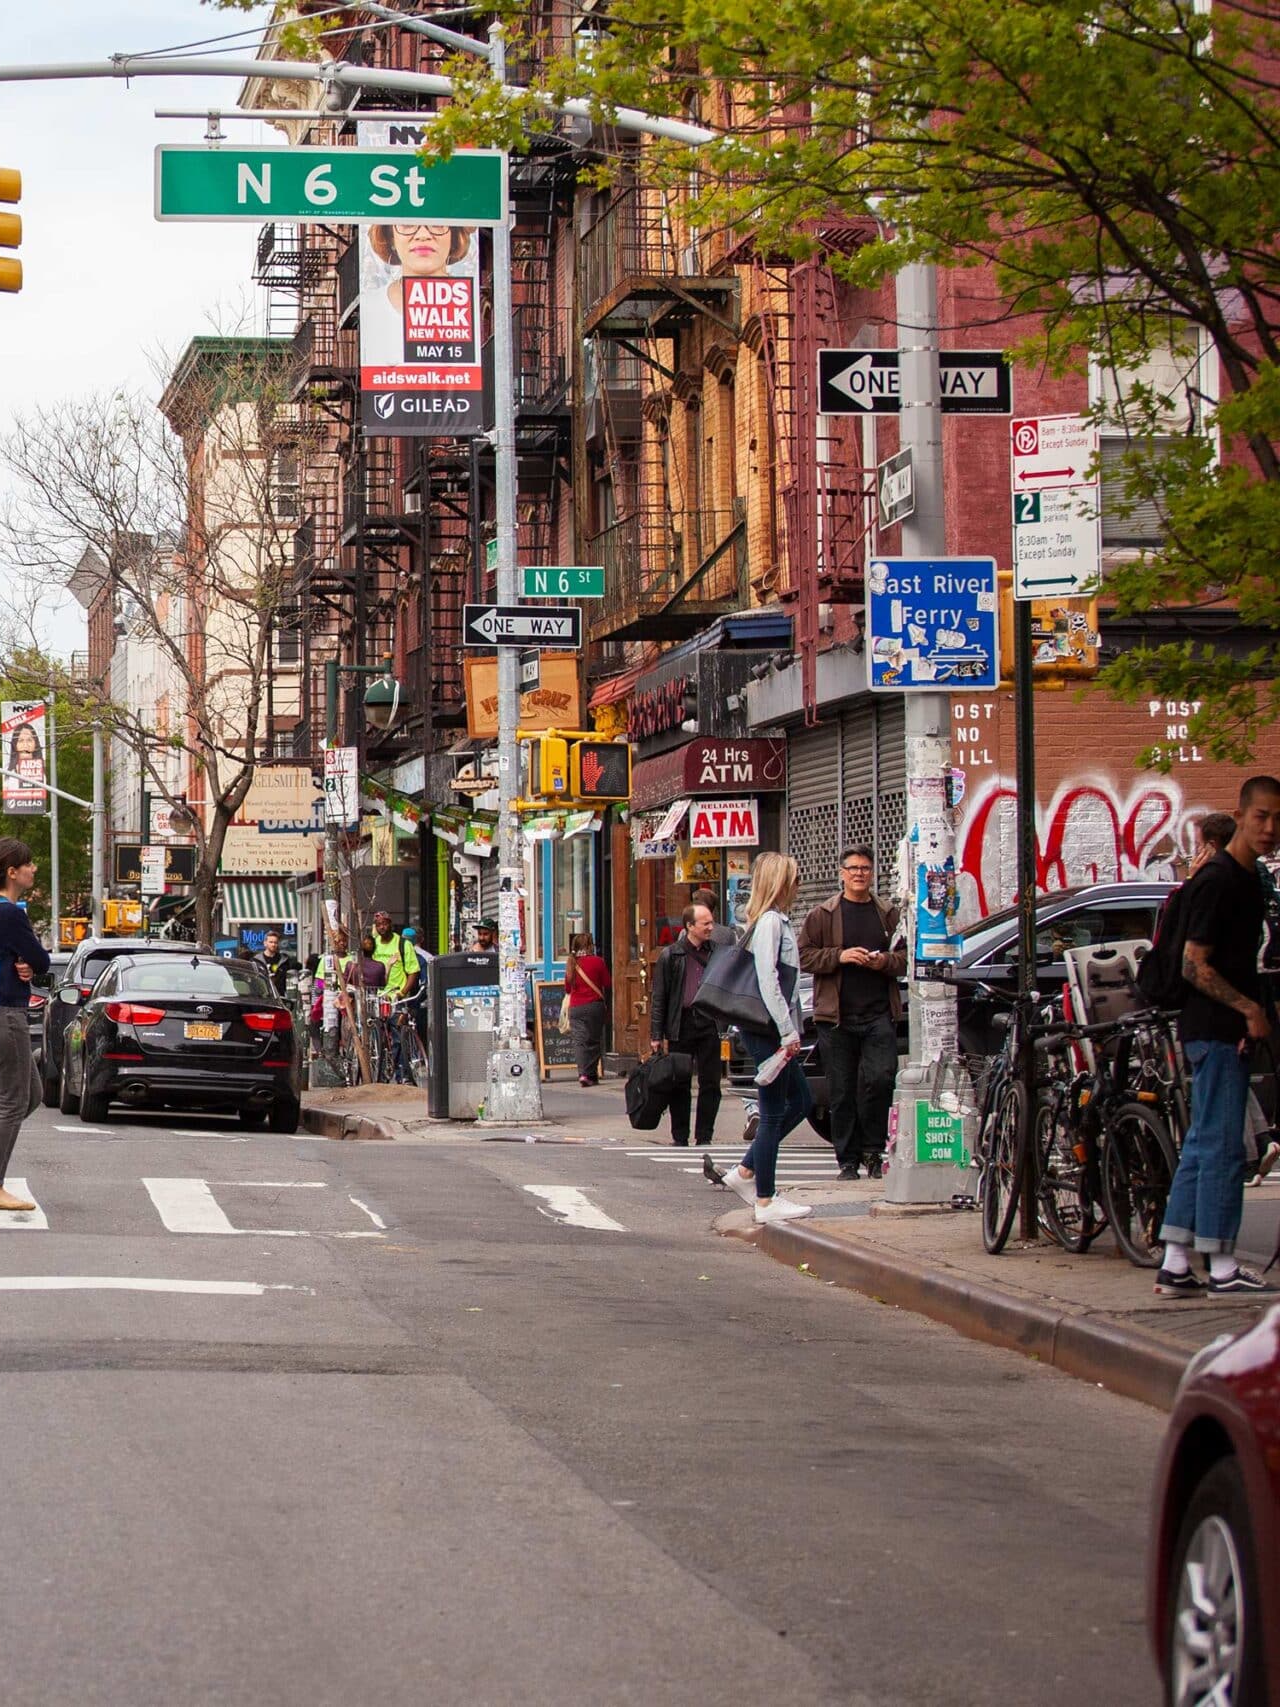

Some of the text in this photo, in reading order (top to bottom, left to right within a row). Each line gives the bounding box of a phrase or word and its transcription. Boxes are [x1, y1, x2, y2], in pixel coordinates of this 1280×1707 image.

[389, 126, 426, 145] NY
[237, 163, 426, 207] N 6 St
[408, 281, 468, 305] AIDS
[408, 307, 468, 326] WALK
[409, 328, 469, 339] NEW YORK
[417, 346, 462, 358] MAY 15
[373, 371, 470, 384] aidswalk.net
[850, 370, 900, 394] ONE
[401, 398, 470, 413] GILEAD
[1041, 427, 1057, 436] 8am
[1061, 424, 1084, 434] 8:30a
[1041, 437, 1088, 450] Except Sunday
[1021, 493, 1058, 521] 2 hour
[1043, 513, 1069, 523] parking
[1019, 536, 1047, 546] 8:30am
[1056, 533, 1073, 544] 7pm
[1019, 547, 1077, 561] Except Sunday
[535, 571, 590, 592] N 6 St
[886, 574, 990, 594] ast River
[902, 606, 962, 630] Ferry
[482, 618, 565, 635] ONE WAY
[531, 688, 571, 710] CRUZ
[954, 704, 993, 719] OST
[1149, 701, 1201, 717] POST
[957, 727, 980, 742] NO
[1167, 724, 1188, 740] NO
[702, 747, 749, 763] 24 Hrs
[959, 749, 993, 765] ILL
[20, 760, 43, 770] AIDS
[254, 773, 308, 788] GELSMITH
[699, 764, 753, 784] ATM
[327, 779, 334, 791] 2
[700, 802, 748, 810] RELIABLE
[693, 811, 755, 839] ATM
[230, 857, 309, 867] 718 384-6004
[928, 1117, 952, 1128] HEAD
[925, 1132, 955, 1144] SHOTS
[929, 1148, 952, 1159] .COM
